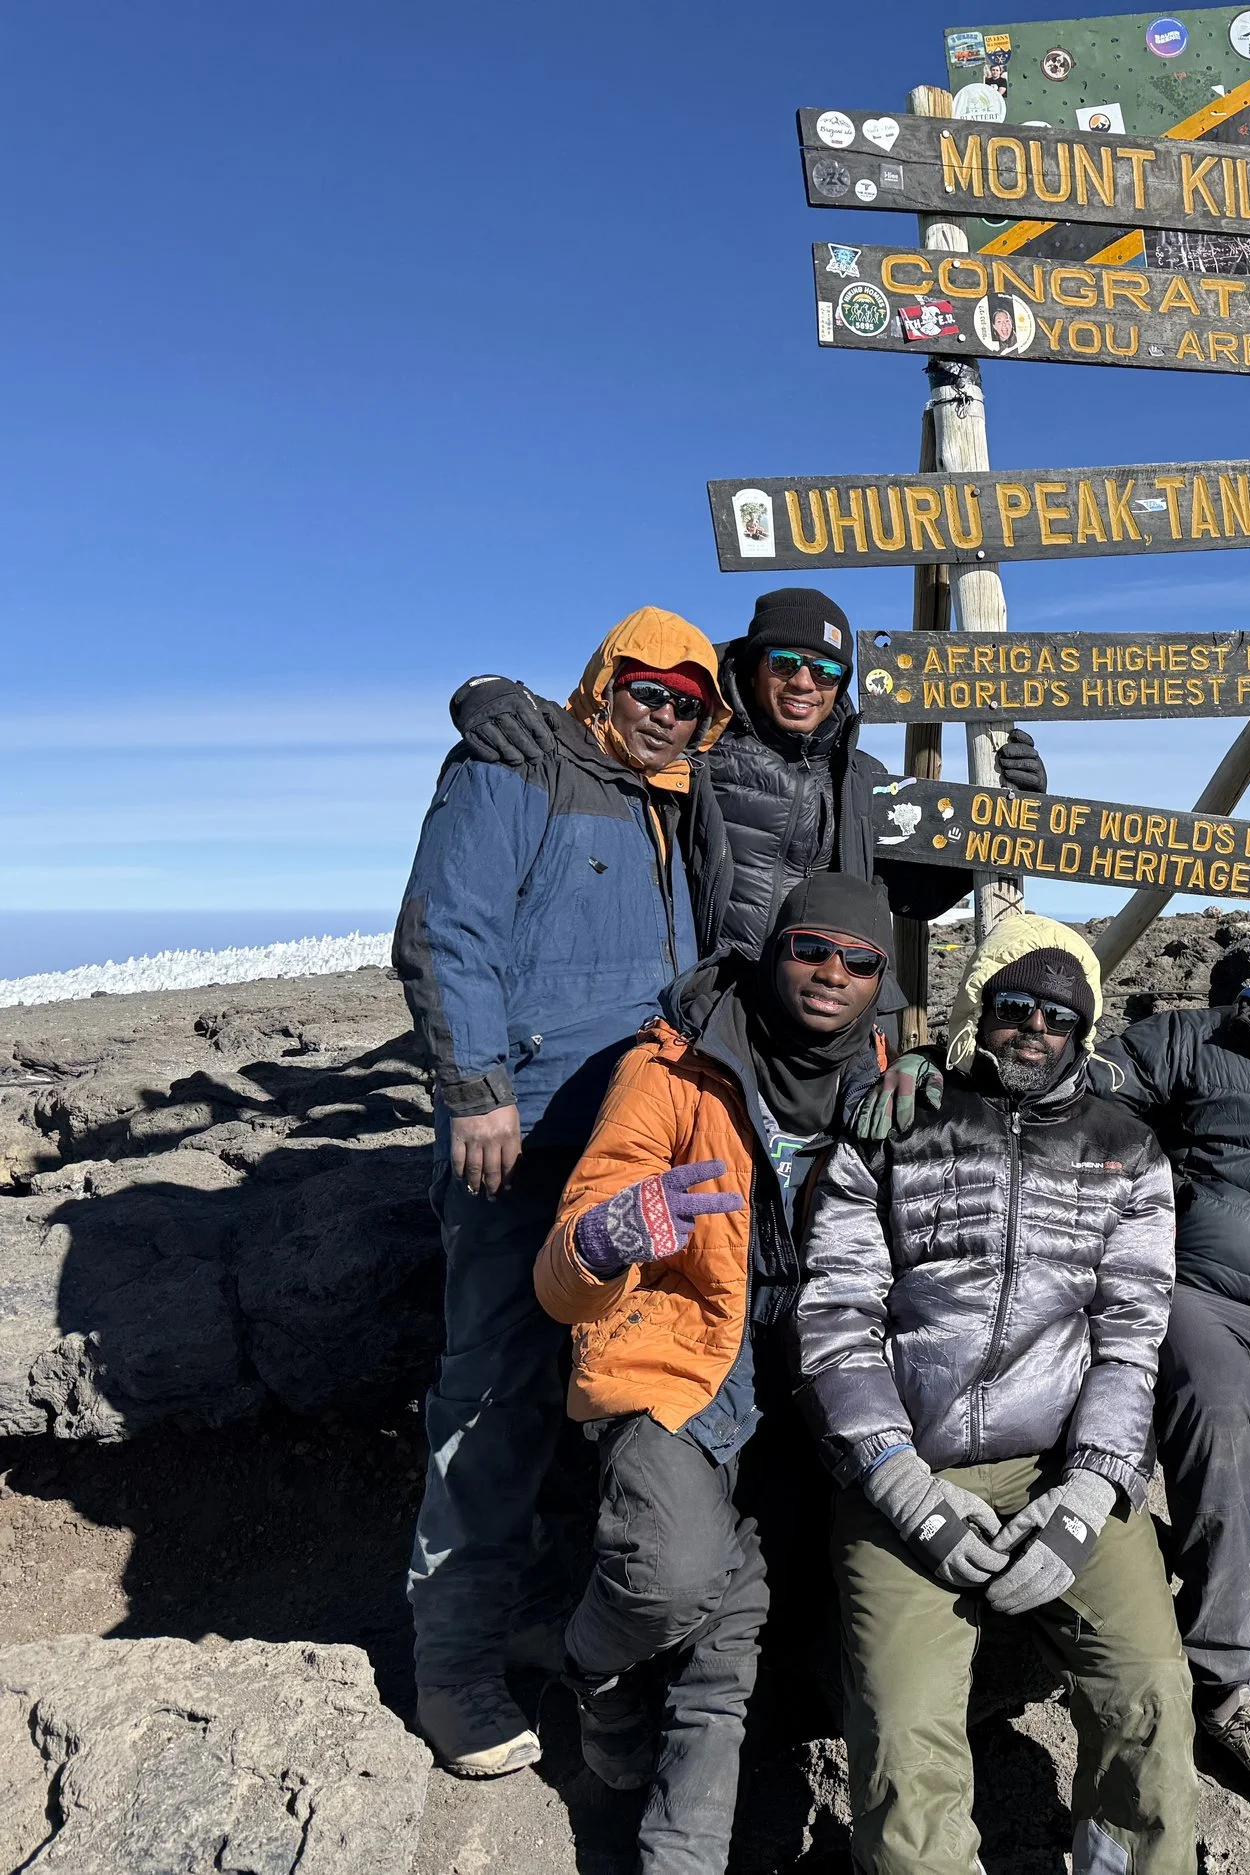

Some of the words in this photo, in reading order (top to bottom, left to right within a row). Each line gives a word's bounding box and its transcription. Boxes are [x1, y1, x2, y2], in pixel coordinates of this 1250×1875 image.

[939, 135, 1157, 210] MOUNT
[864, 286, 885, 308] HOMIES
[855, 322, 874, 330] 5895
[1039, 318, 1140, 357] YOU
[786, 483, 984, 555] UHURU
[995, 478, 1151, 548] PEAK,
[1091, 643, 1232, 673] HIGHEST
[922, 678, 1071, 709] WORLD'S
[1081, 675, 1229, 706] HIGHEST
[970, 792, 1041, 832] ONE
[1049, 803, 1090, 835] OF
[1099, 809, 1236, 855] WORLD'S
[965, 831, 1082, 874] WORLD
